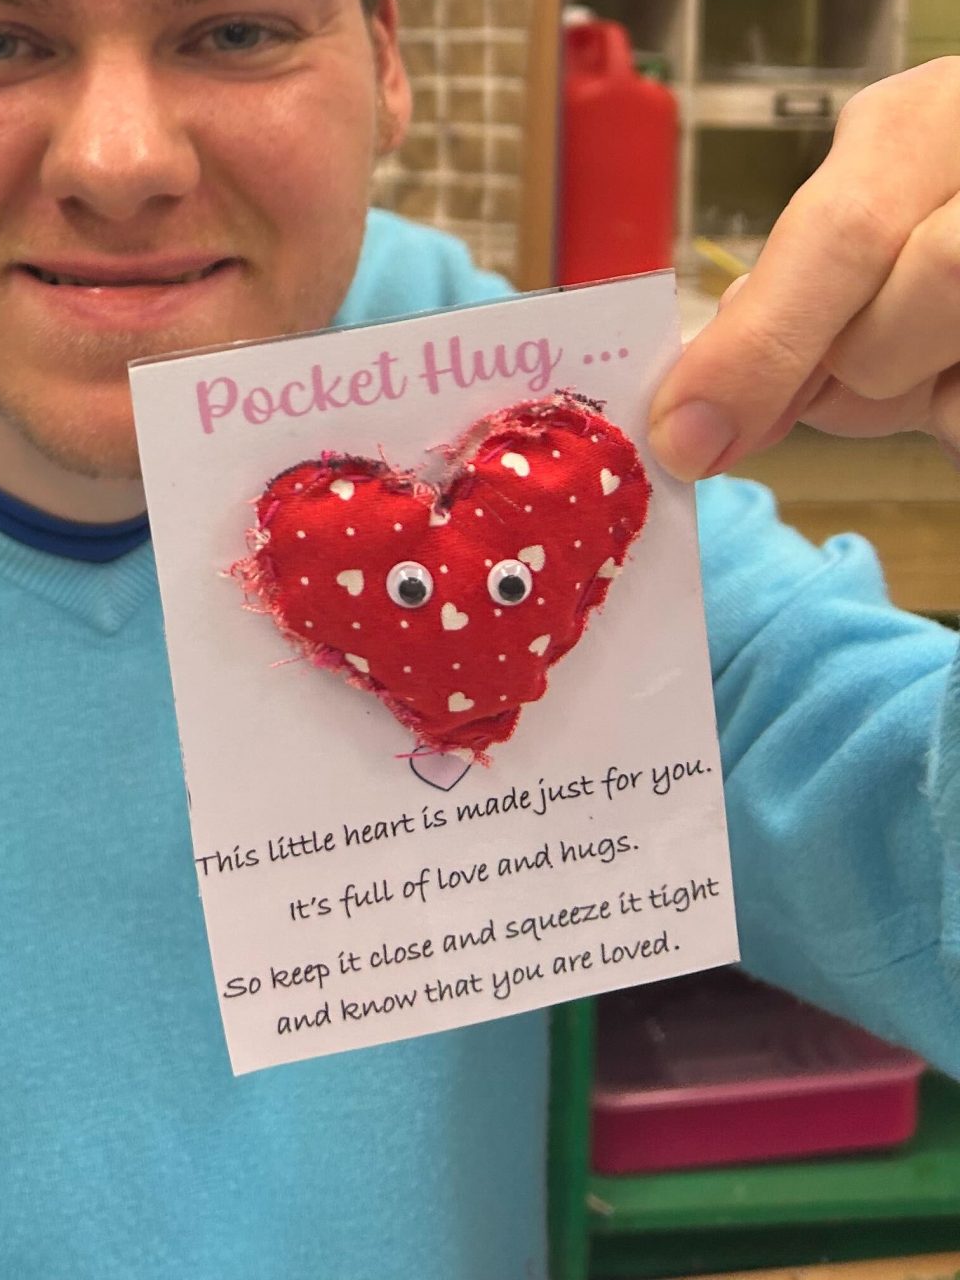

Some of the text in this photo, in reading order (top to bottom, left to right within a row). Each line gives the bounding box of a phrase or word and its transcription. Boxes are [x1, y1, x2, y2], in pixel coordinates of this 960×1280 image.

[195, 350, 408, 434] Pocket
[417, 334, 564, 396] Hug
[195, 759, 712, 878] This little heart is made just for you.
[289, 835, 639, 921] It's full of love and hugs.
[222, 877, 720, 999] So keep it close and squeeze it tight
[277, 931, 680, 1036] and know that you are loved.
